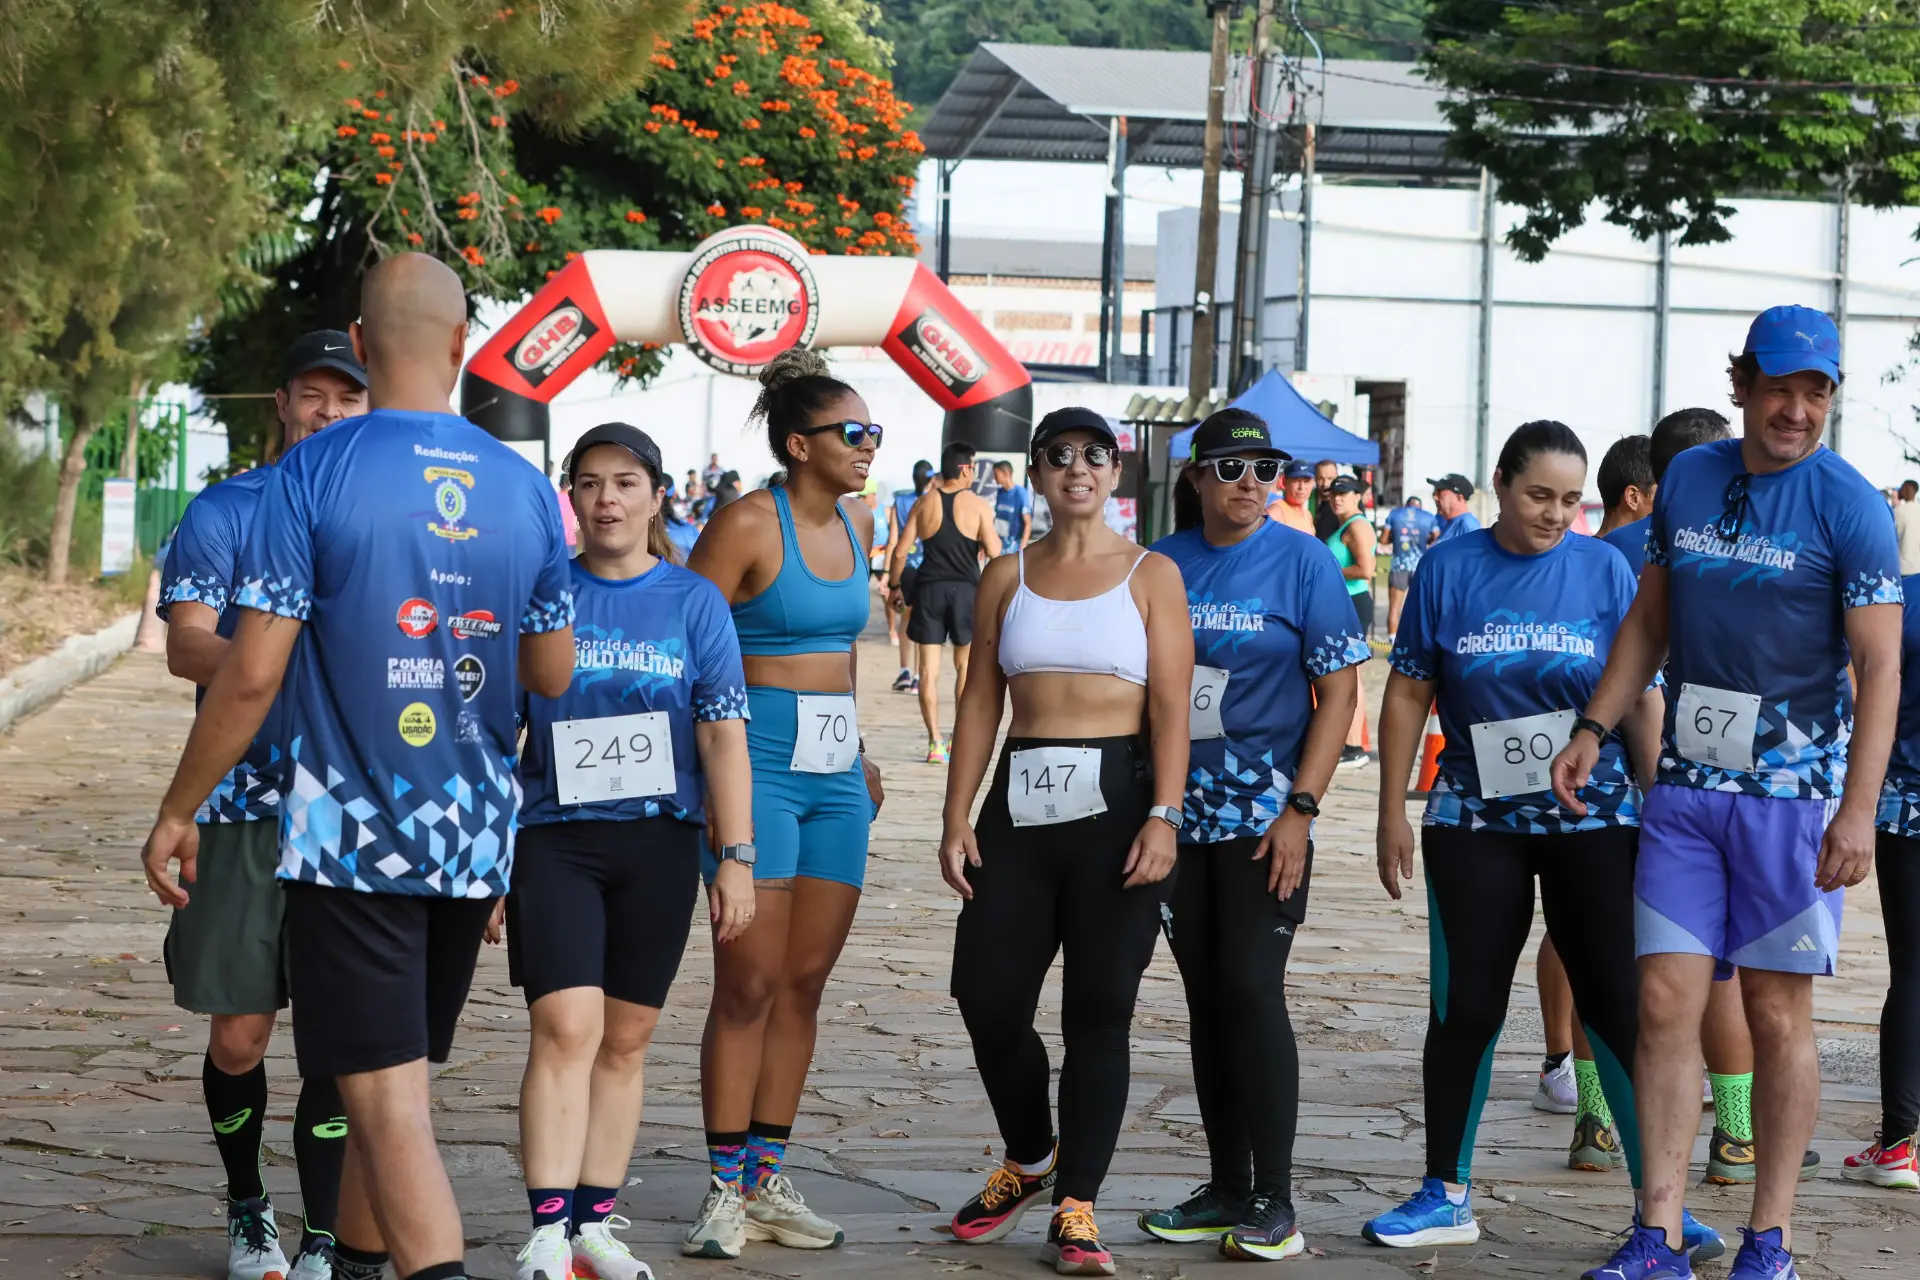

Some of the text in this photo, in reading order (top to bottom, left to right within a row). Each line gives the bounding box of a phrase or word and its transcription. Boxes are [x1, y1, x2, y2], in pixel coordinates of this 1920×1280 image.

[697, 297, 801, 315] ASSEEMG
[523, 315, 577, 366] GHB
[922, 324, 973, 377] GHB
[413, 443, 480, 464] Realização:
[1673, 526, 1796, 571] CÍRCULO MILITAR
[1754, 535, 1770, 547] do
[1220, 601, 1237, 613] do
[1203, 613, 1265, 632] MILITAR
[1483, 622, 1568, 635] Corrida do
[635, 641, 655, 654] do
[1456, 631, 1596, 658] CÍRCULO MILITAR
[387, 671, 445, 685] MILITAR
[618, 650, 685, 679] MILITAR
[816, 713, 848, 743] 70
[1694, 705, 1738, 739] 67
[574, 733, 653, 770] 249
[1503, 732, 1553, 765] 80
[1020, 764, 1077, 796] 147
